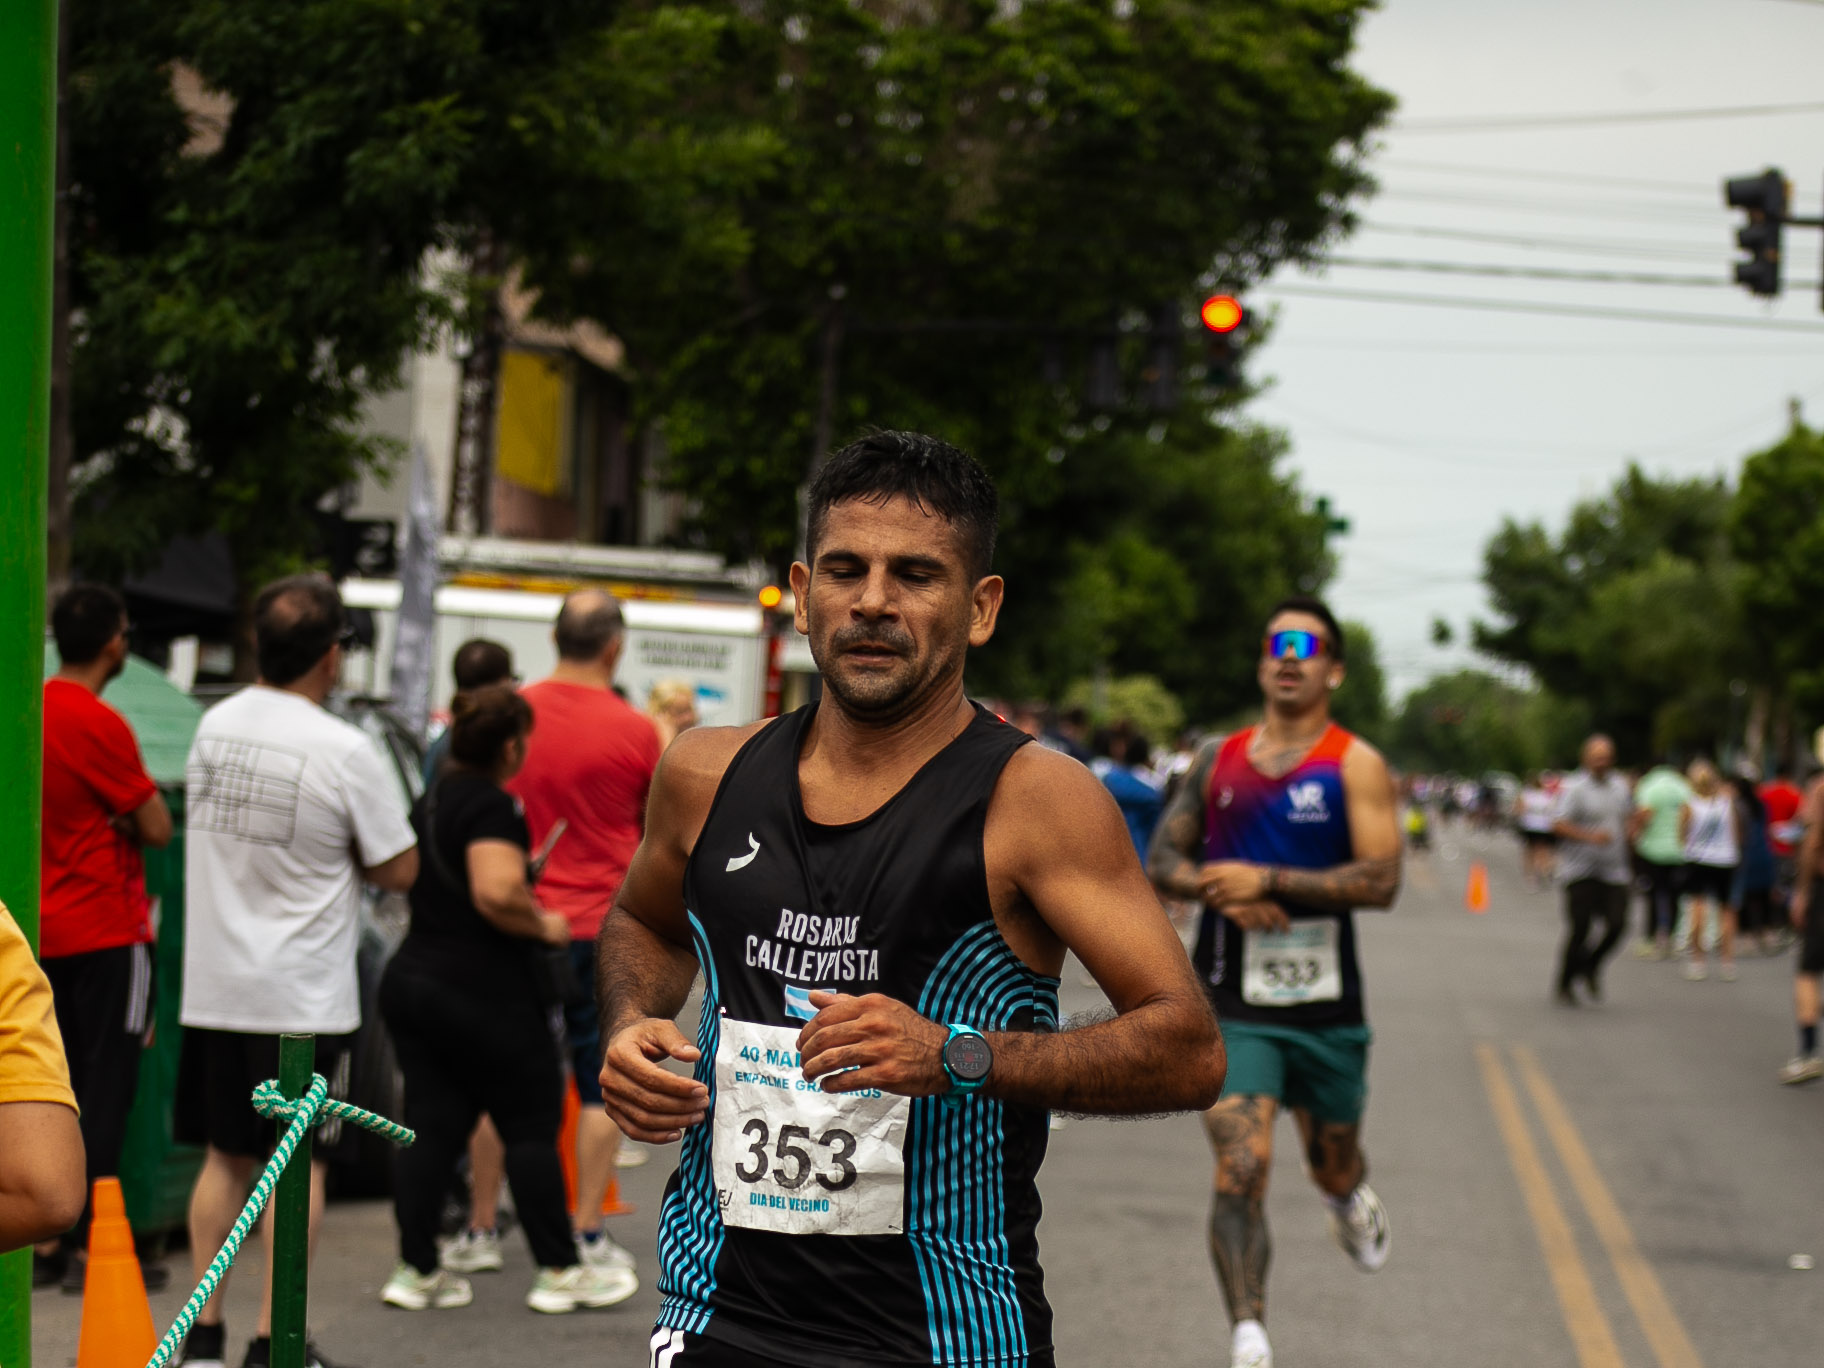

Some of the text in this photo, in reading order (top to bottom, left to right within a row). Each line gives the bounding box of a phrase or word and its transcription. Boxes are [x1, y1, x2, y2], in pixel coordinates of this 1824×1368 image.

[1263, 957, 1321, 988] 533
[740, 1045, 760, 1064] 40
[735, 1071, 790, 1090] EMPALME
[735, 1118, 858, 1191] 353
[749, 1192, 830, 1212] DIA DEL VECINO
